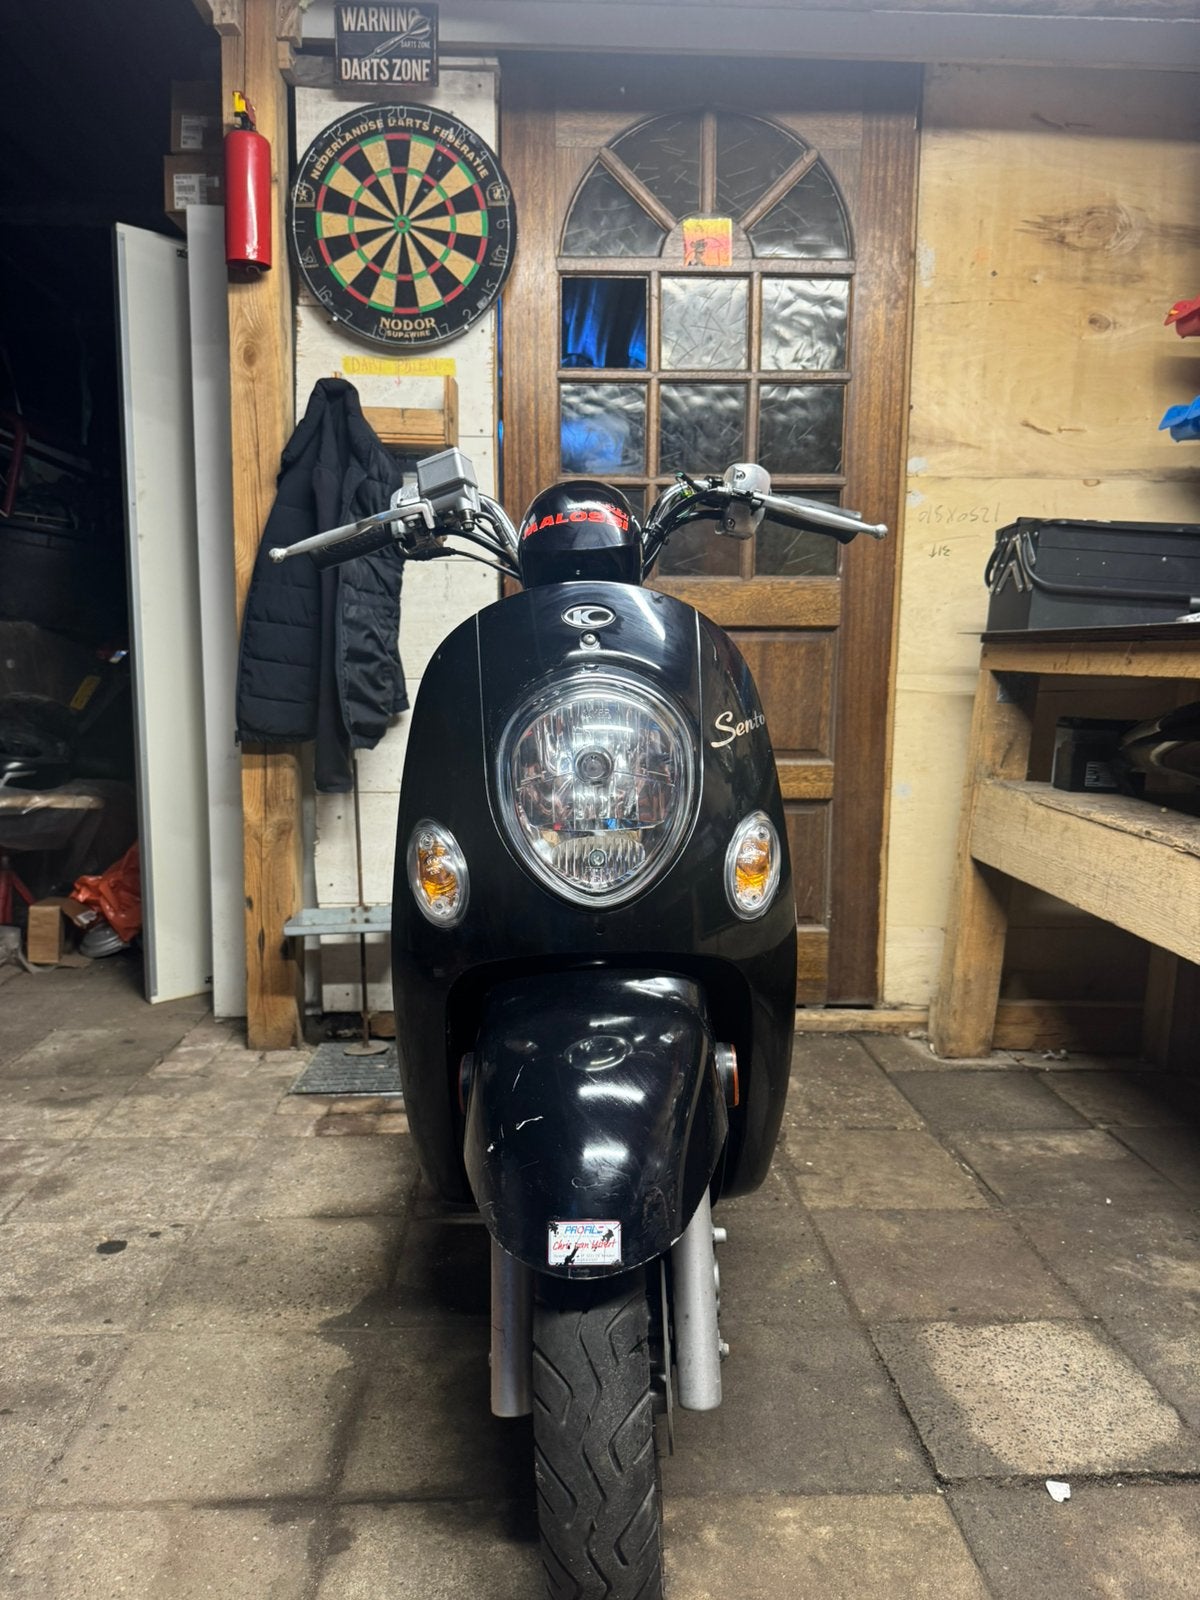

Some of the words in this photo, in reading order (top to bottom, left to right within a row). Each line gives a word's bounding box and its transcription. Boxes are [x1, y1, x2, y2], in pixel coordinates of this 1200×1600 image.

[341, 58, 389, 81] DARTS
[392, 59, 431, 81] ZONE
[310, 119, 385, 180] NEDERLANDSE
[387, 117, 430, 131] DARTS
[432, 125, 489, 179] FEDERATIE
[380, 316, 436, 331] NODOR
[386, 328, 431, 339] SUPAWIRE
[710, 710, 765, 748] Sento
